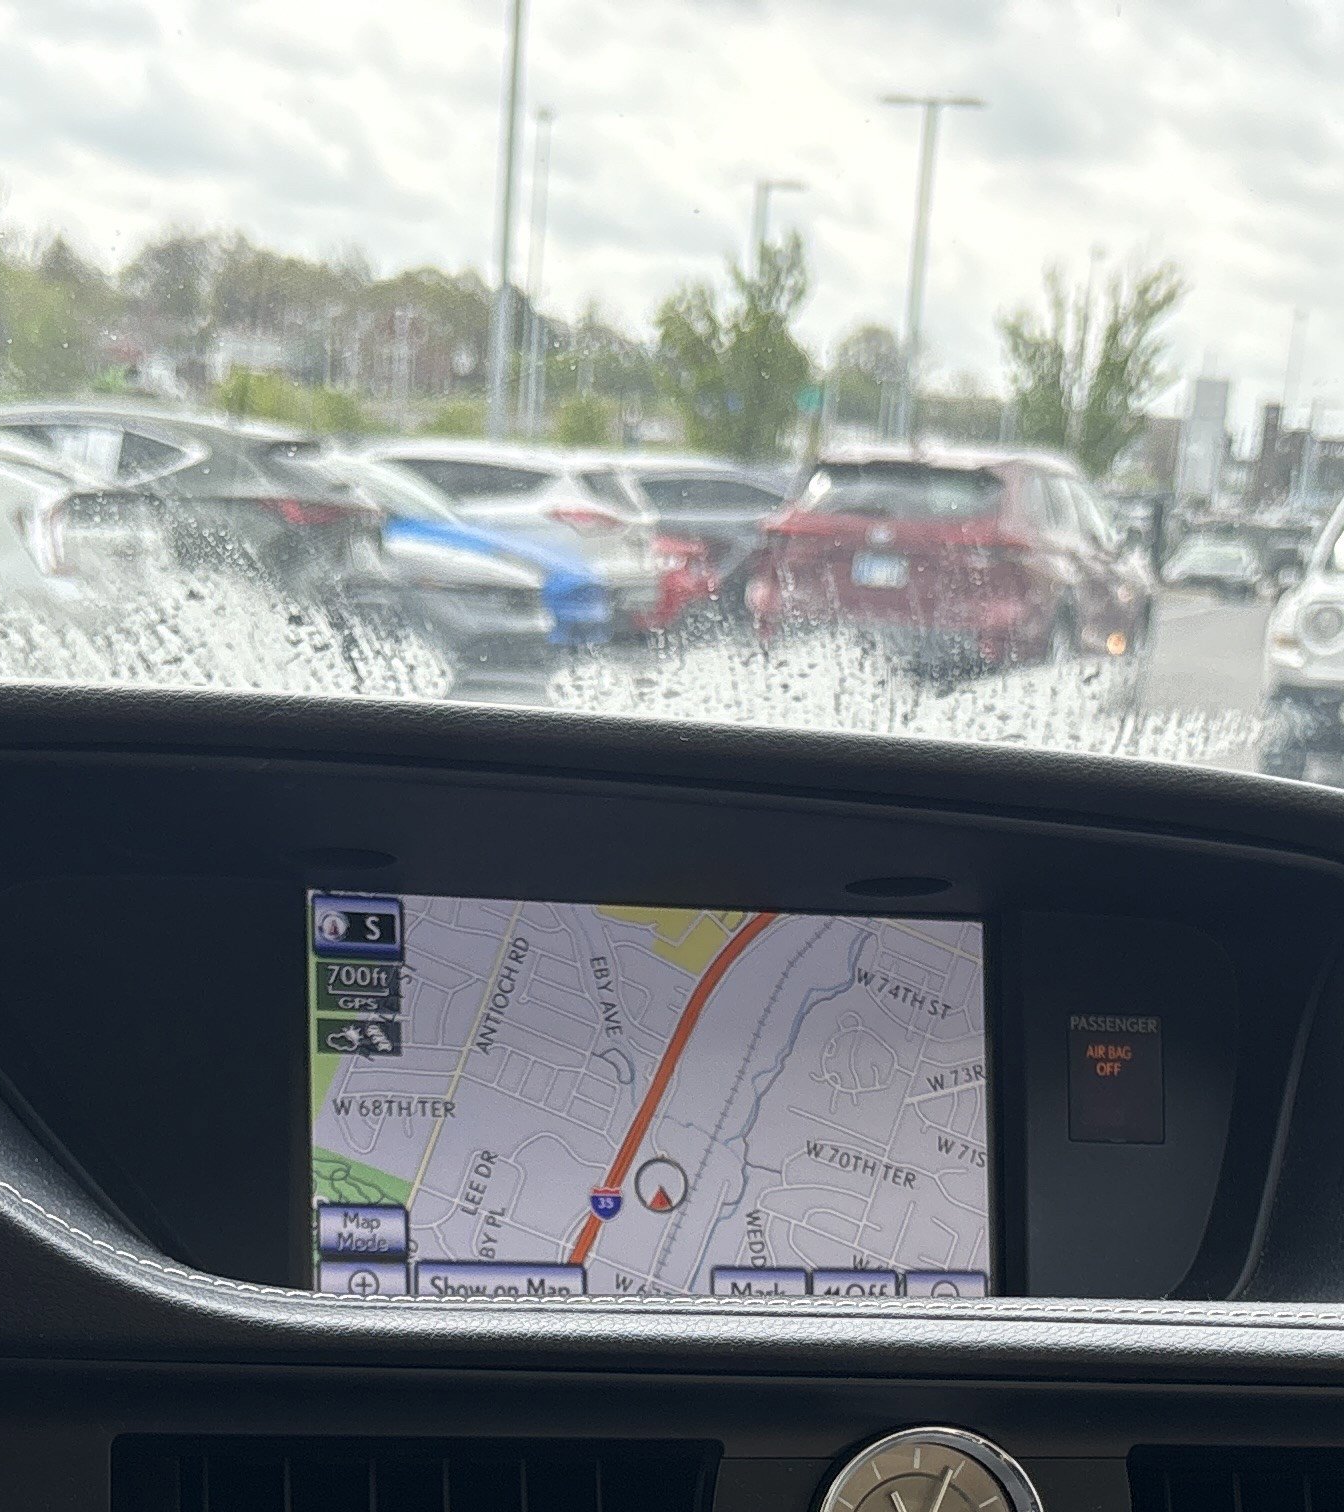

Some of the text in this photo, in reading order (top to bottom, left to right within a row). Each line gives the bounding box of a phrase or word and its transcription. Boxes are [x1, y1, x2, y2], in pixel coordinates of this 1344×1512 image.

[365, 916, 381, 941] S
[327, 965, 388, 987] 700ft
[338, 997, 378, 1010] GPS
[473, 936, 530, 1055] ANTIOCH RD
[590, 956, 623, 1037] EBY AVE
[857, 967, 952, 1020] W 74TH ST
[1070, 1016, 1158, 1033] PASSENGER
[1096, 1061, 1122, 1076] OFF
[926, 1075, 945, 1091] W
[333, 1100, 456, 1118] W 68TH TER
[937, 1135, 956, 1155] W
[806, 1139, 917, 1189] W 70TH TER
[461, 1150, 499, 1216] LEE DR
[342, 1211, 381, 1232] Map
[337, 1232, 388, 1251] Mode
[479, 1206, 506, 1260] BY PL
[430, 1275, 570, 1295] Show on Map
